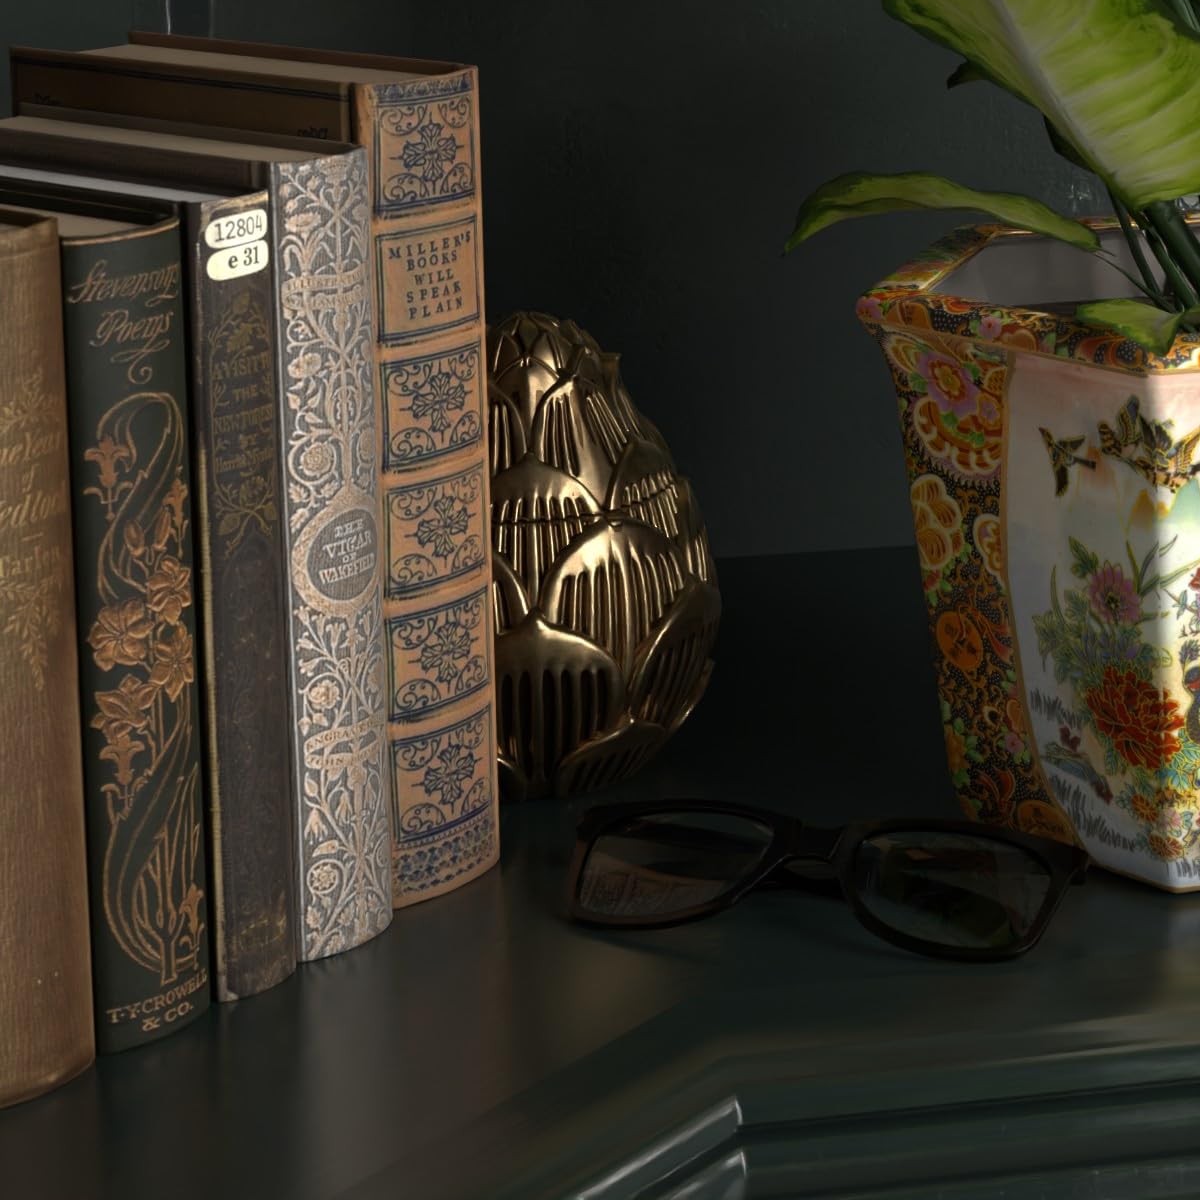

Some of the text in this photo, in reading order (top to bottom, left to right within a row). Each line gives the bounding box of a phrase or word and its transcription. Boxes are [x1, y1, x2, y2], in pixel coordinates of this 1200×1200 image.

[214, 214, 262, 242] 12804
[388, 230, 471, 259] MILLER'S
[228, 245, 260, 270] e 31
[406, 249, 458, 272] BOOKS
[414, 268, 455, 286] WILL
[406, 280, 462, 304] SPEAK
[408, 297, 463, 320] PLAIN
[334, 518, 364, 539] THE
[322, 530, 373, 559] VICAR
[142, 1001, 194, 1032] & CO.
